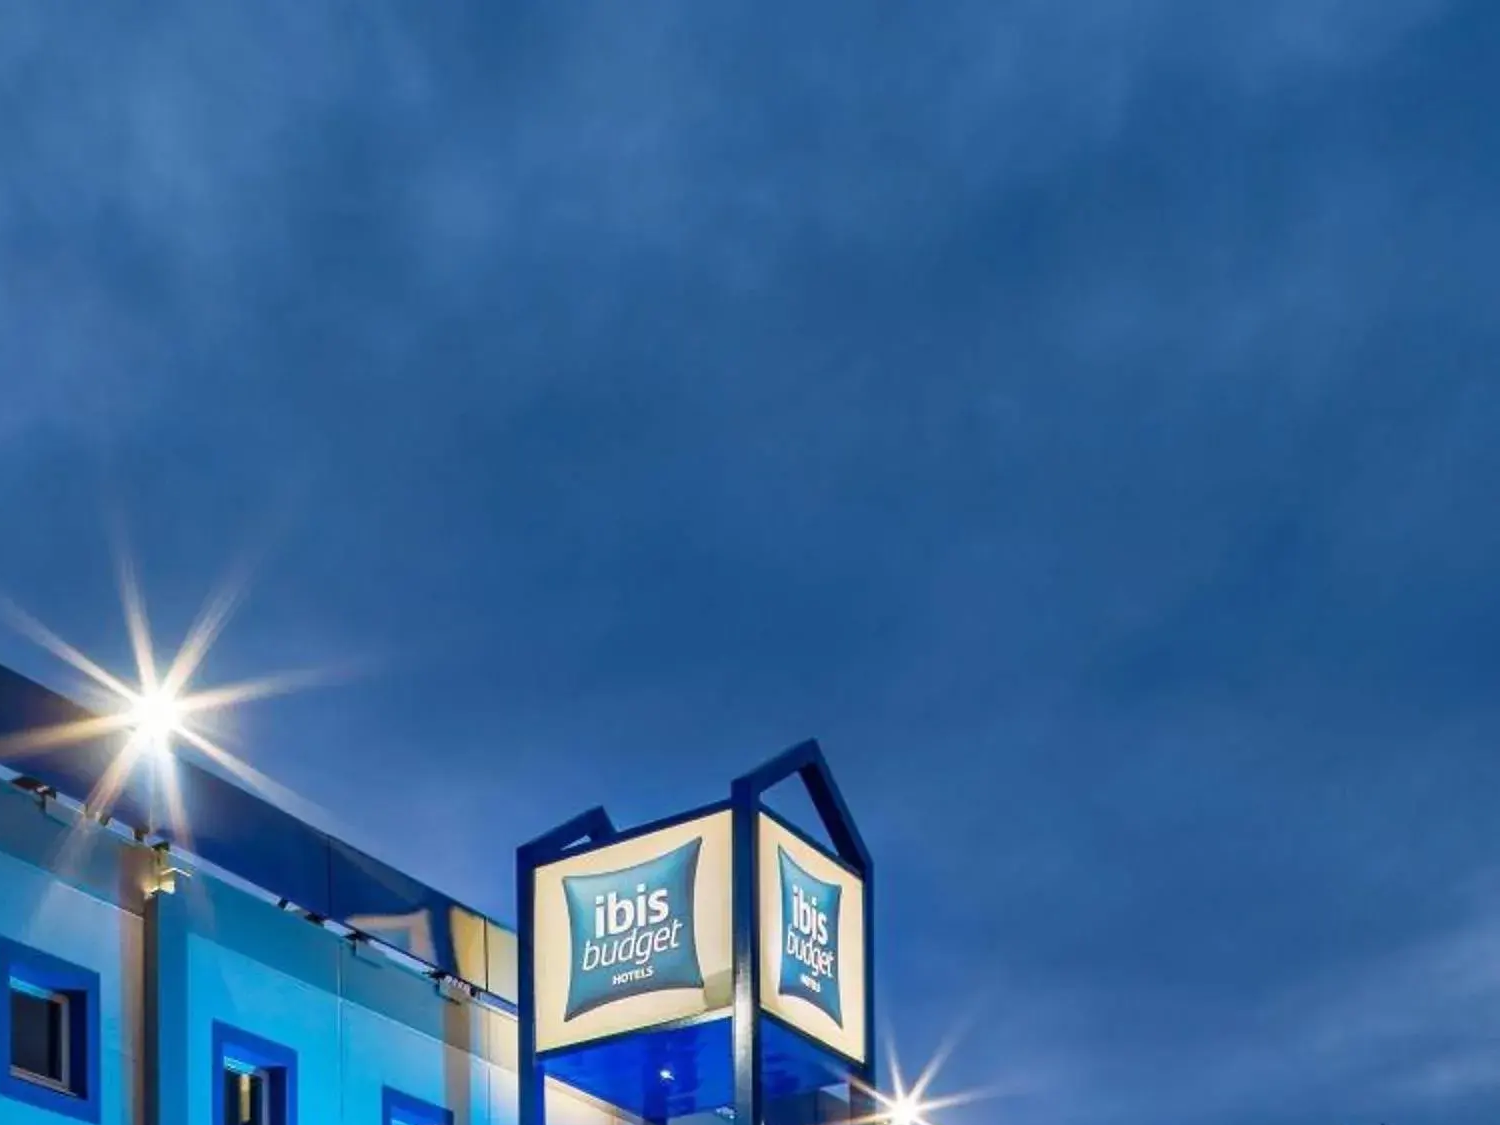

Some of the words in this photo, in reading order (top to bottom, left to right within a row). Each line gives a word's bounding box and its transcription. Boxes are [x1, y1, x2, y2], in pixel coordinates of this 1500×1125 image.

[595, 883, 669, 938] ibis
[792, 884, 828, 945] ibis
[582, 919, 683, 971] budget
[787, 923, 835, 978] budget
[612, 965, 654, 985] HOTELS
